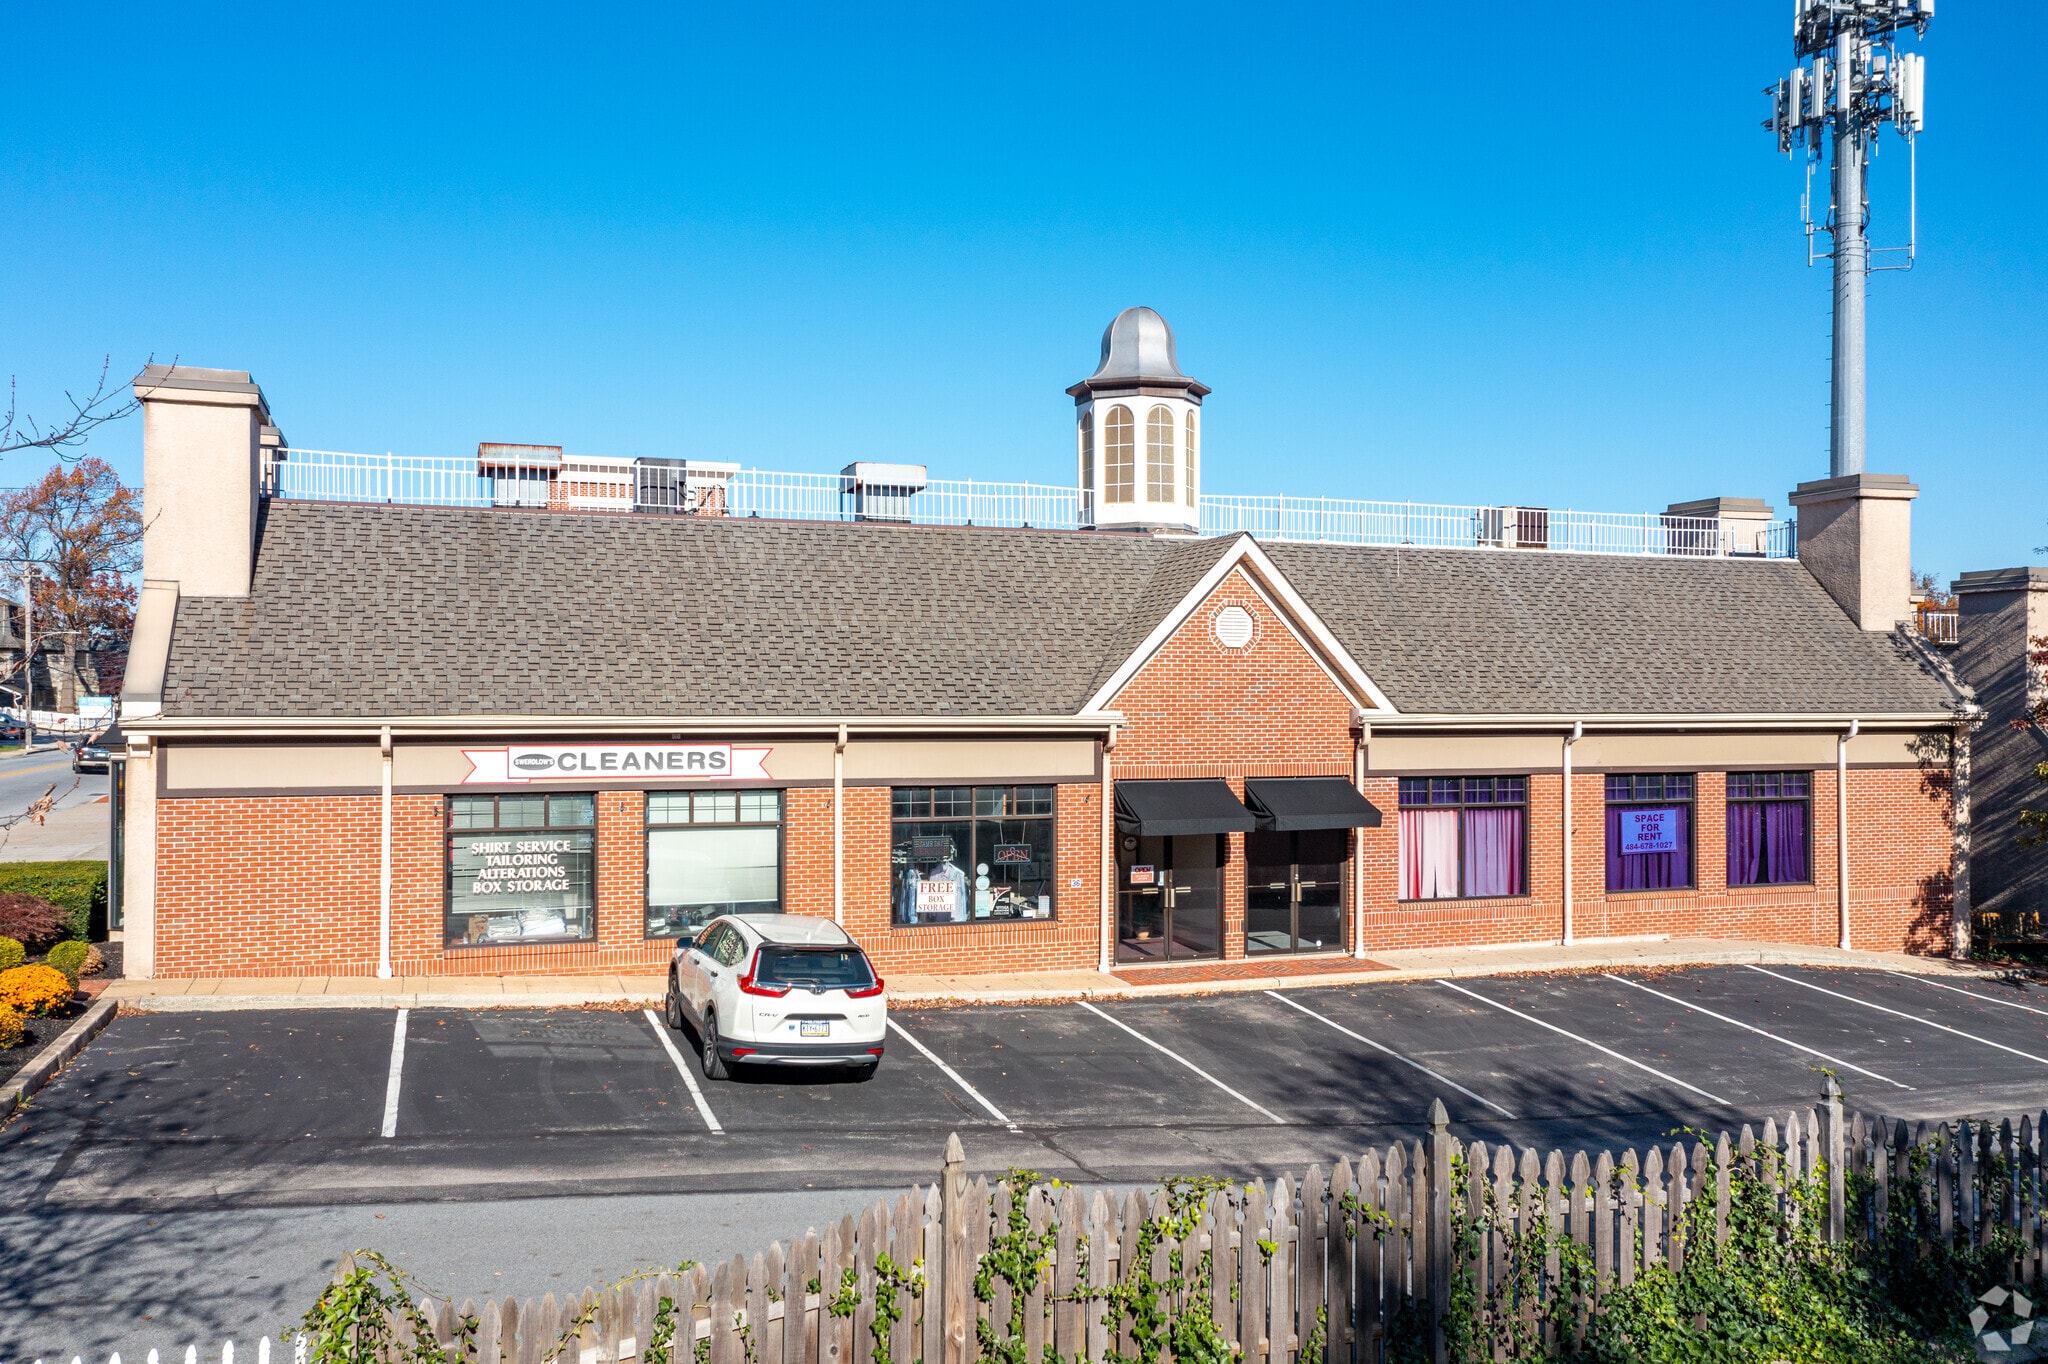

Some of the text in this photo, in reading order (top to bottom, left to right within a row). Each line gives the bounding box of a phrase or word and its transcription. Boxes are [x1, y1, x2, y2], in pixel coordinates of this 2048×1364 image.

[557, 751, 726, 771] CLEANERS
[1634, 814, 1664, 822] SPACE
[1641, 824, 1659, 832] FOR
[1638, 832, 1662, 841] RENT
[471, 840, 571, 854] SHIRT SERVICE
[1625, 841, 1673, 850] 484-678-1027
[485, 853, 558, 867] TAILORING
[997, 849, 1028, 861] OPEN
[477, 866, 566, 880] ALTERATIONS
[472, 879, 570, 894] BOX STORAGE
[920, 882, 954, 893] FREE
[928, 895, 945, 903] BOX
[918, 903, 954, 911] STORAGE
